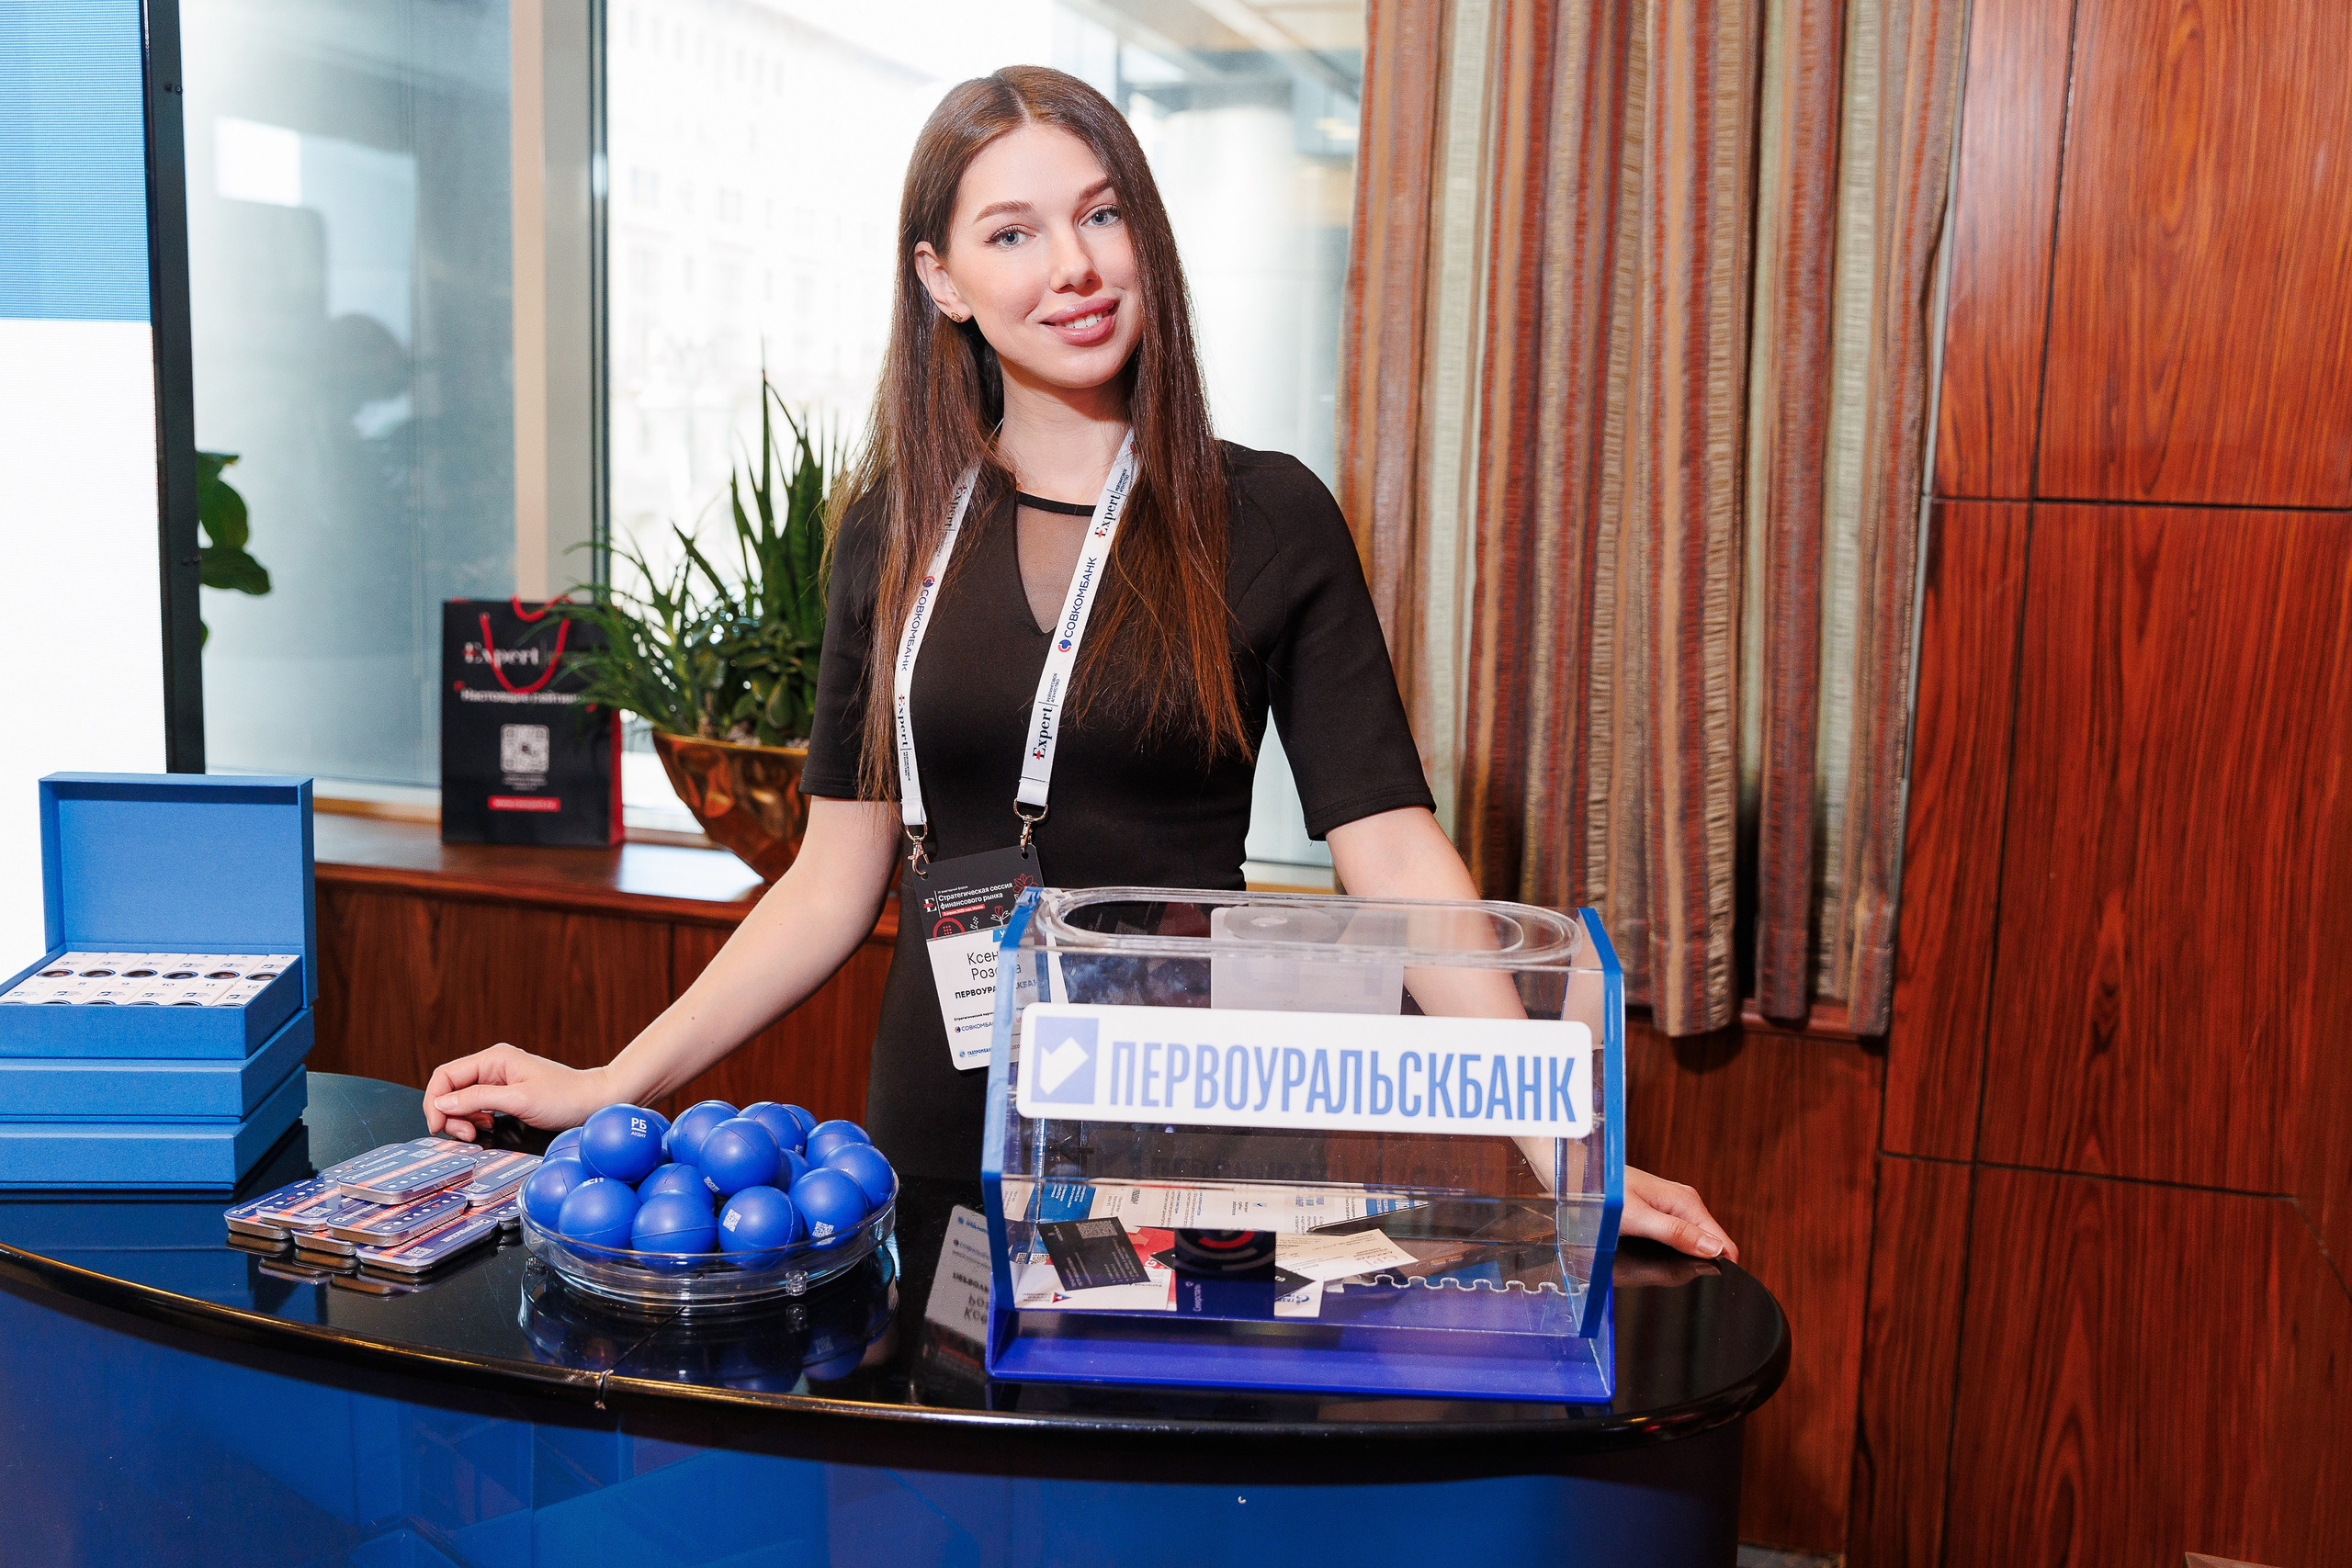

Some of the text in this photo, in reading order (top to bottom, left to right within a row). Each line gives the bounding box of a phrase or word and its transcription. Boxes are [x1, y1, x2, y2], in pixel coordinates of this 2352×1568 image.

[1094, 494, 1121, 538] Expert
[1064, 556, 1097, 638] СОВКОМБАНК
[901, 588, 930, 671] СОВКОМБАНК
[898, 694, 909, 747] Expert
[1032, 706, 1054, 761] Expert
[938, 882, 1013, 902] Стратегическая сессия
[940, 892, 1003, 910] финансового рынка
[961, 1021, 994, 1032] СОВКОМБА
[1110, 1041, 1577, 1122] ПЕРВОУРАЛЬСКБАНК
[630, 1117, 647, 1130] РБ
